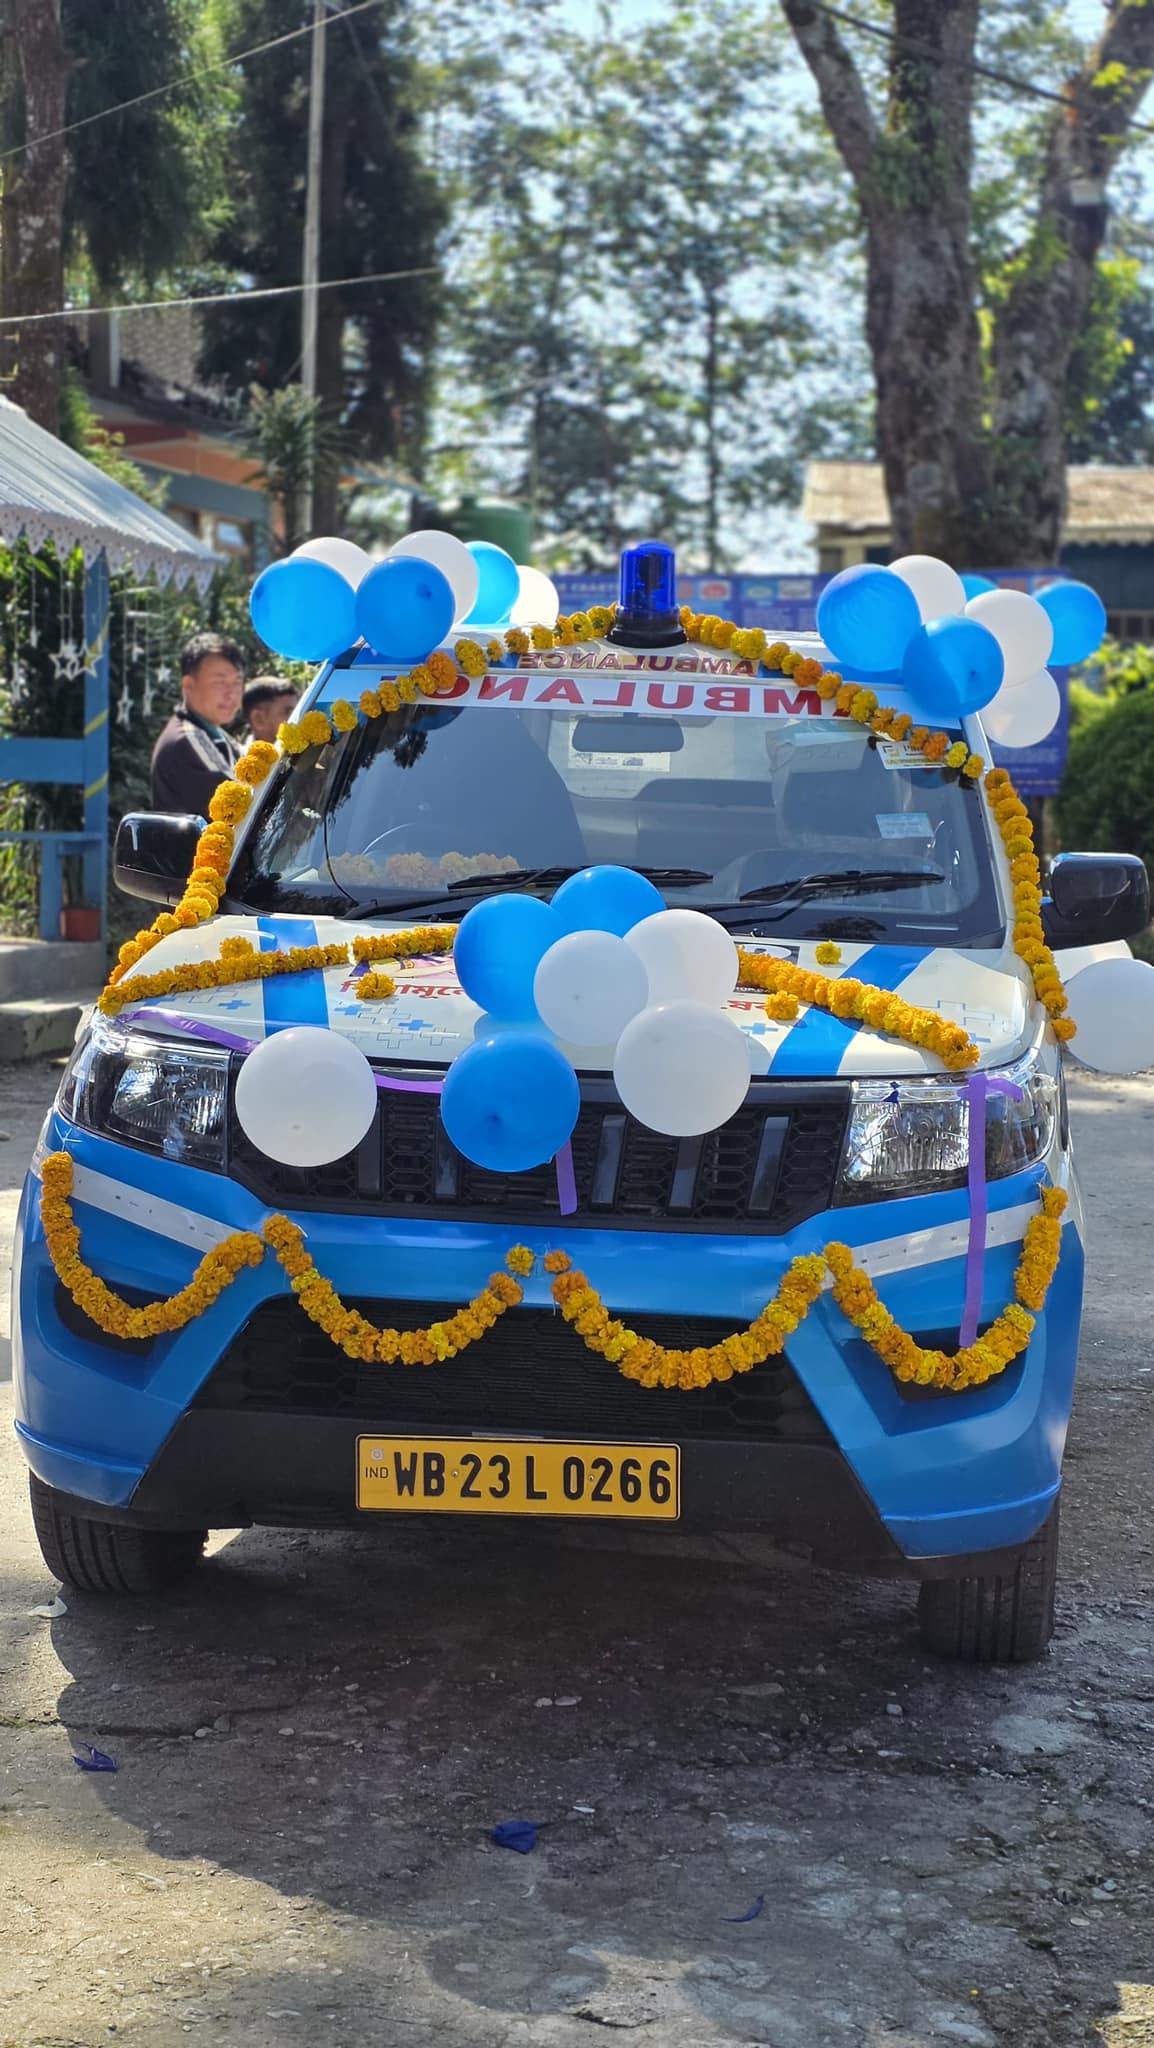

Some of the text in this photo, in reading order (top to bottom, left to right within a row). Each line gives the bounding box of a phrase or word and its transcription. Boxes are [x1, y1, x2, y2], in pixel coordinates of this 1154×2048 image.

[365, 1467, 389, 1480] IND
[394, 1452, 672, 1504] WB 23 L 0266
